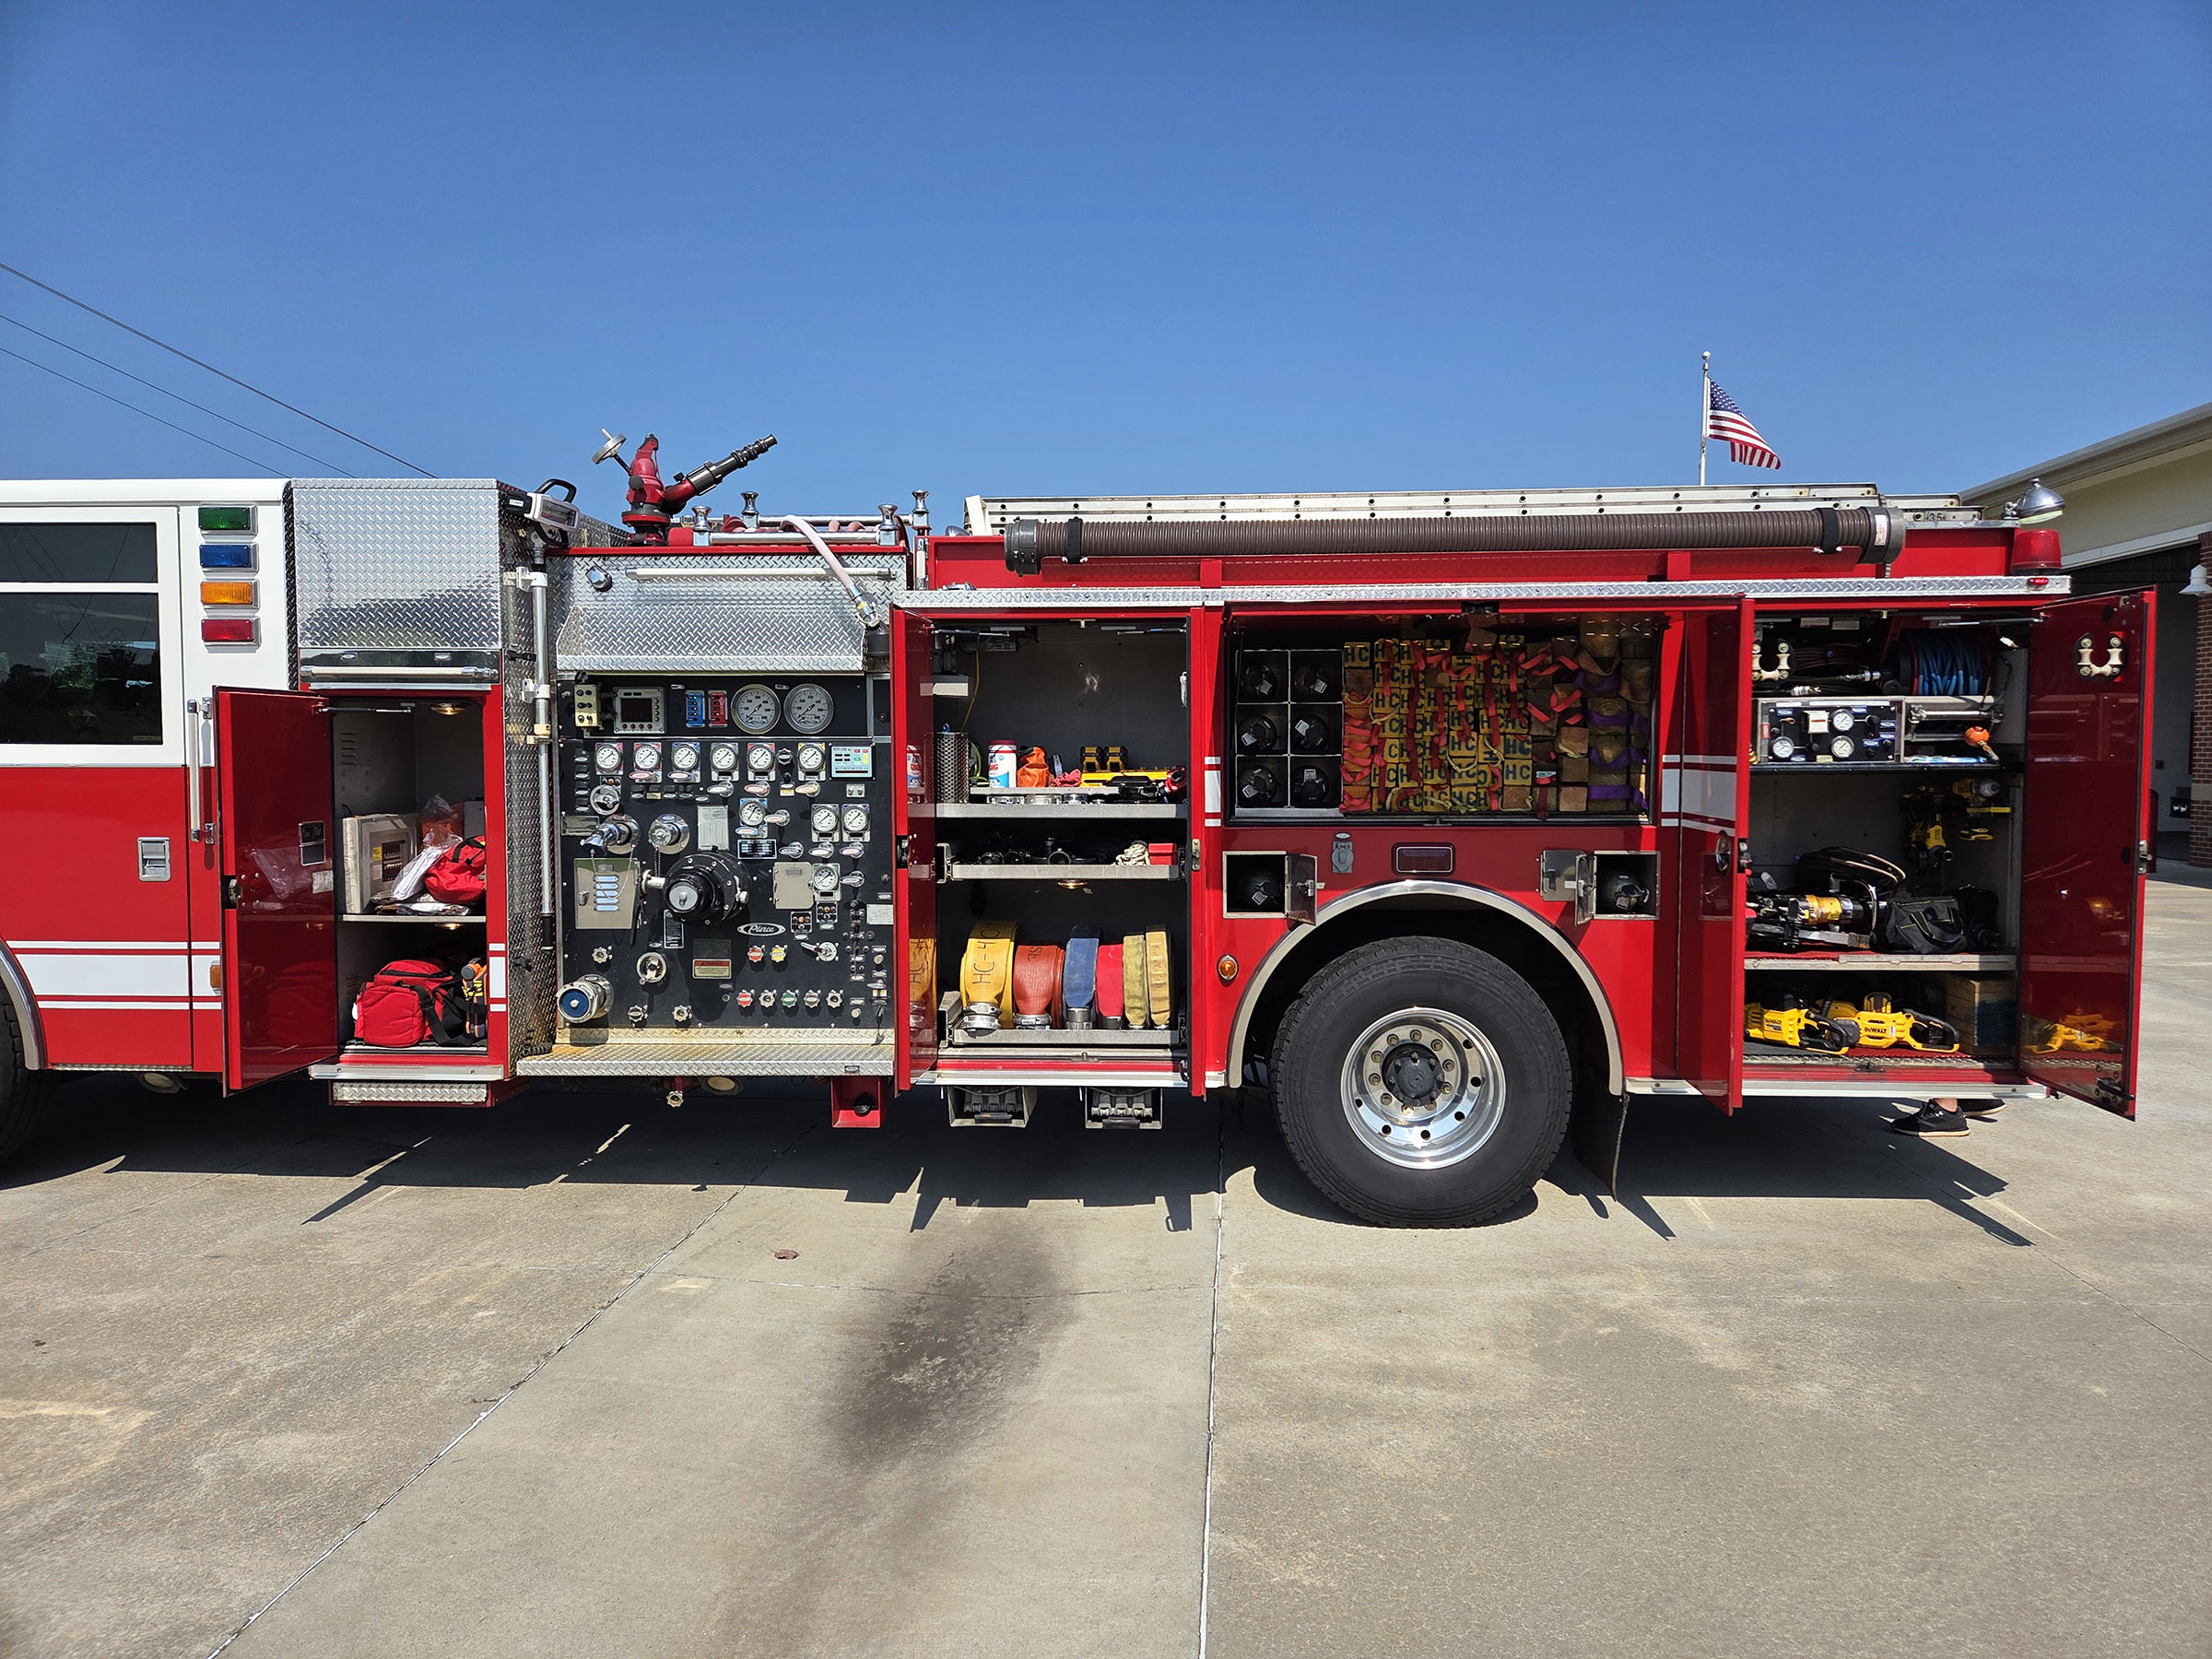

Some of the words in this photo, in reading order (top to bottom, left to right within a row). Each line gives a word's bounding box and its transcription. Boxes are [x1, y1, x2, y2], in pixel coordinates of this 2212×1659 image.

[1345, 646, 1369, 662] HC
[1375, 692, 1400, 708] HC
[1452, 736, 1476, 751] HC
[1504, 739, 1531, 755] HC
[1452, 763, 1476, 779] HC
[1505, 765, 1530, 780] HC
[747, 924, 774, 934] Pierce
